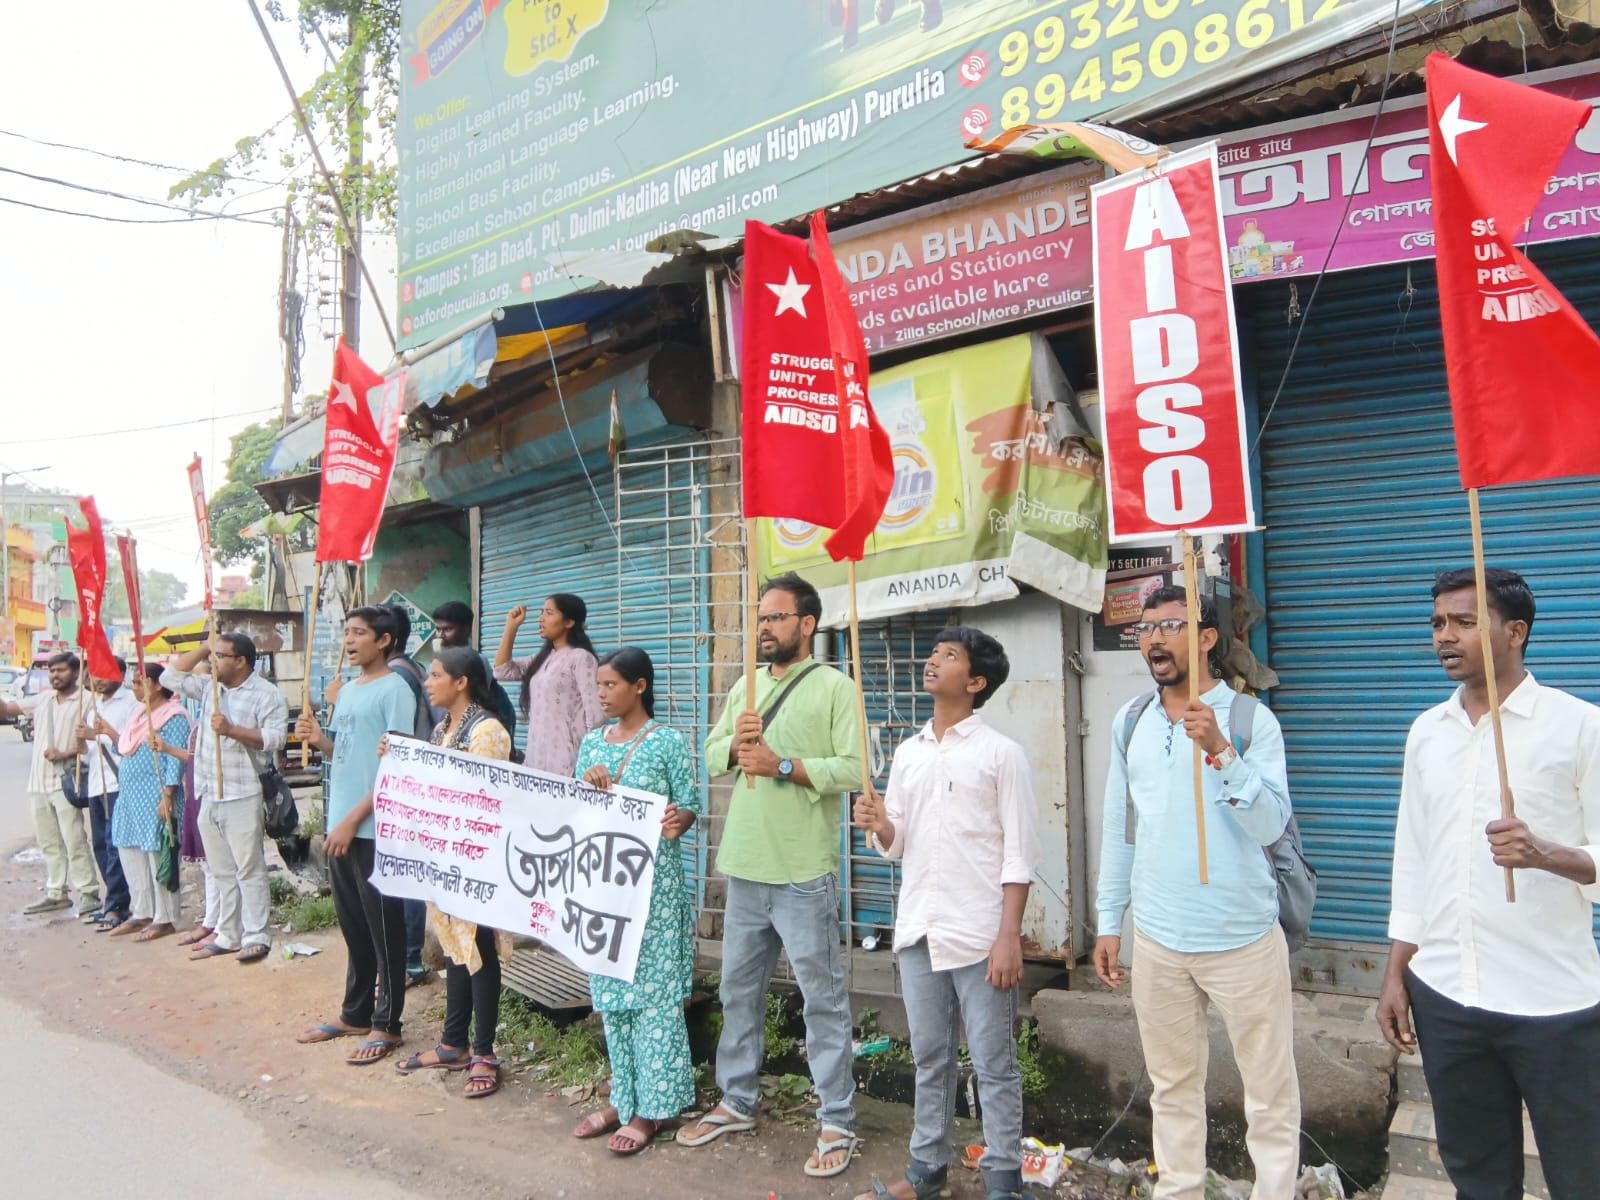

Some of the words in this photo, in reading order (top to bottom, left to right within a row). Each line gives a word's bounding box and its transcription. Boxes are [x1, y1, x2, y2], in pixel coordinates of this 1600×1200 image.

[430, 25, 465, 69] GOING
[465, 5, 483, 32] ON
[530, 24, 560, 58] Std.
[566, 13, 577, 39] X
[544, 3, 561, 25] to
[415, 122, 461, 157] Digital
[465, 87, 530, 132] Learning
[534, 53, 600, 96] System.
[415, 148, 461, 182] Highly
[464, 121, 520, 159] Trained
[523, 89, 585, 131] Faculty.
[415, 150, 505, 208] International
[510, 117, 589, 166] Language
[593, 73, 680, 126] Learning.
[1258, 137, 1293, 158] রাধে
[414, 266, 461, 301] Campus
[471, 252, 497, 279] Tata
[500, 235, 537, 272] Road,
[569, 180, 669, 240] Dulmi-Nadiha
[673, 163, 718, 206] (Near
[723, 142, 761, 180] New
[766, 98, 859, 161] Highway)
[865, 69, 945, 125] Purulia
[415, 200, 464, 234] School
[468, 188, 498, 213] Bus
[502, 160, 561, 197] Facility.
[415, 222, 479, 261] Excellent
[484, 195, 537, 234] School
[541, 165, 615, 208] Campus.
[836, 241, 914, 285] NDA
[921, 191, 1091, 265] BHANDE
[849, 280, 898, 307] eries
[903, 267, 945, 293] and
[949, 237, 1075, 282] Stationery
[859, 310, 885, 330] ds
[891, 286, 987, 324] available
[993, 271, 1050, 298] hare
[414, 280, 513, 329] oxfordpurulia.org.
[895, 325, 925, 343] Zilla
[927, 304, 1021, 336] School/More
[769, 369, 817, 386] UNITY
[770, 352, 836, 371] STRUGGL
[1123, 176, 1213, 526] AIDSO
[764, 404, 838, 434] AIDSO
[887, 571, 961, 598] ANANDA
[1118, 559, 1123, 569] 5
[1125, 558, 1138, 569] GET
[1146, 556, 1164, 568] FREE
[410, 621, 432, 632] OPEN
[505, 823, 655, 899] অঙ্গীকার
[561, 896, 632, 964] সভা
